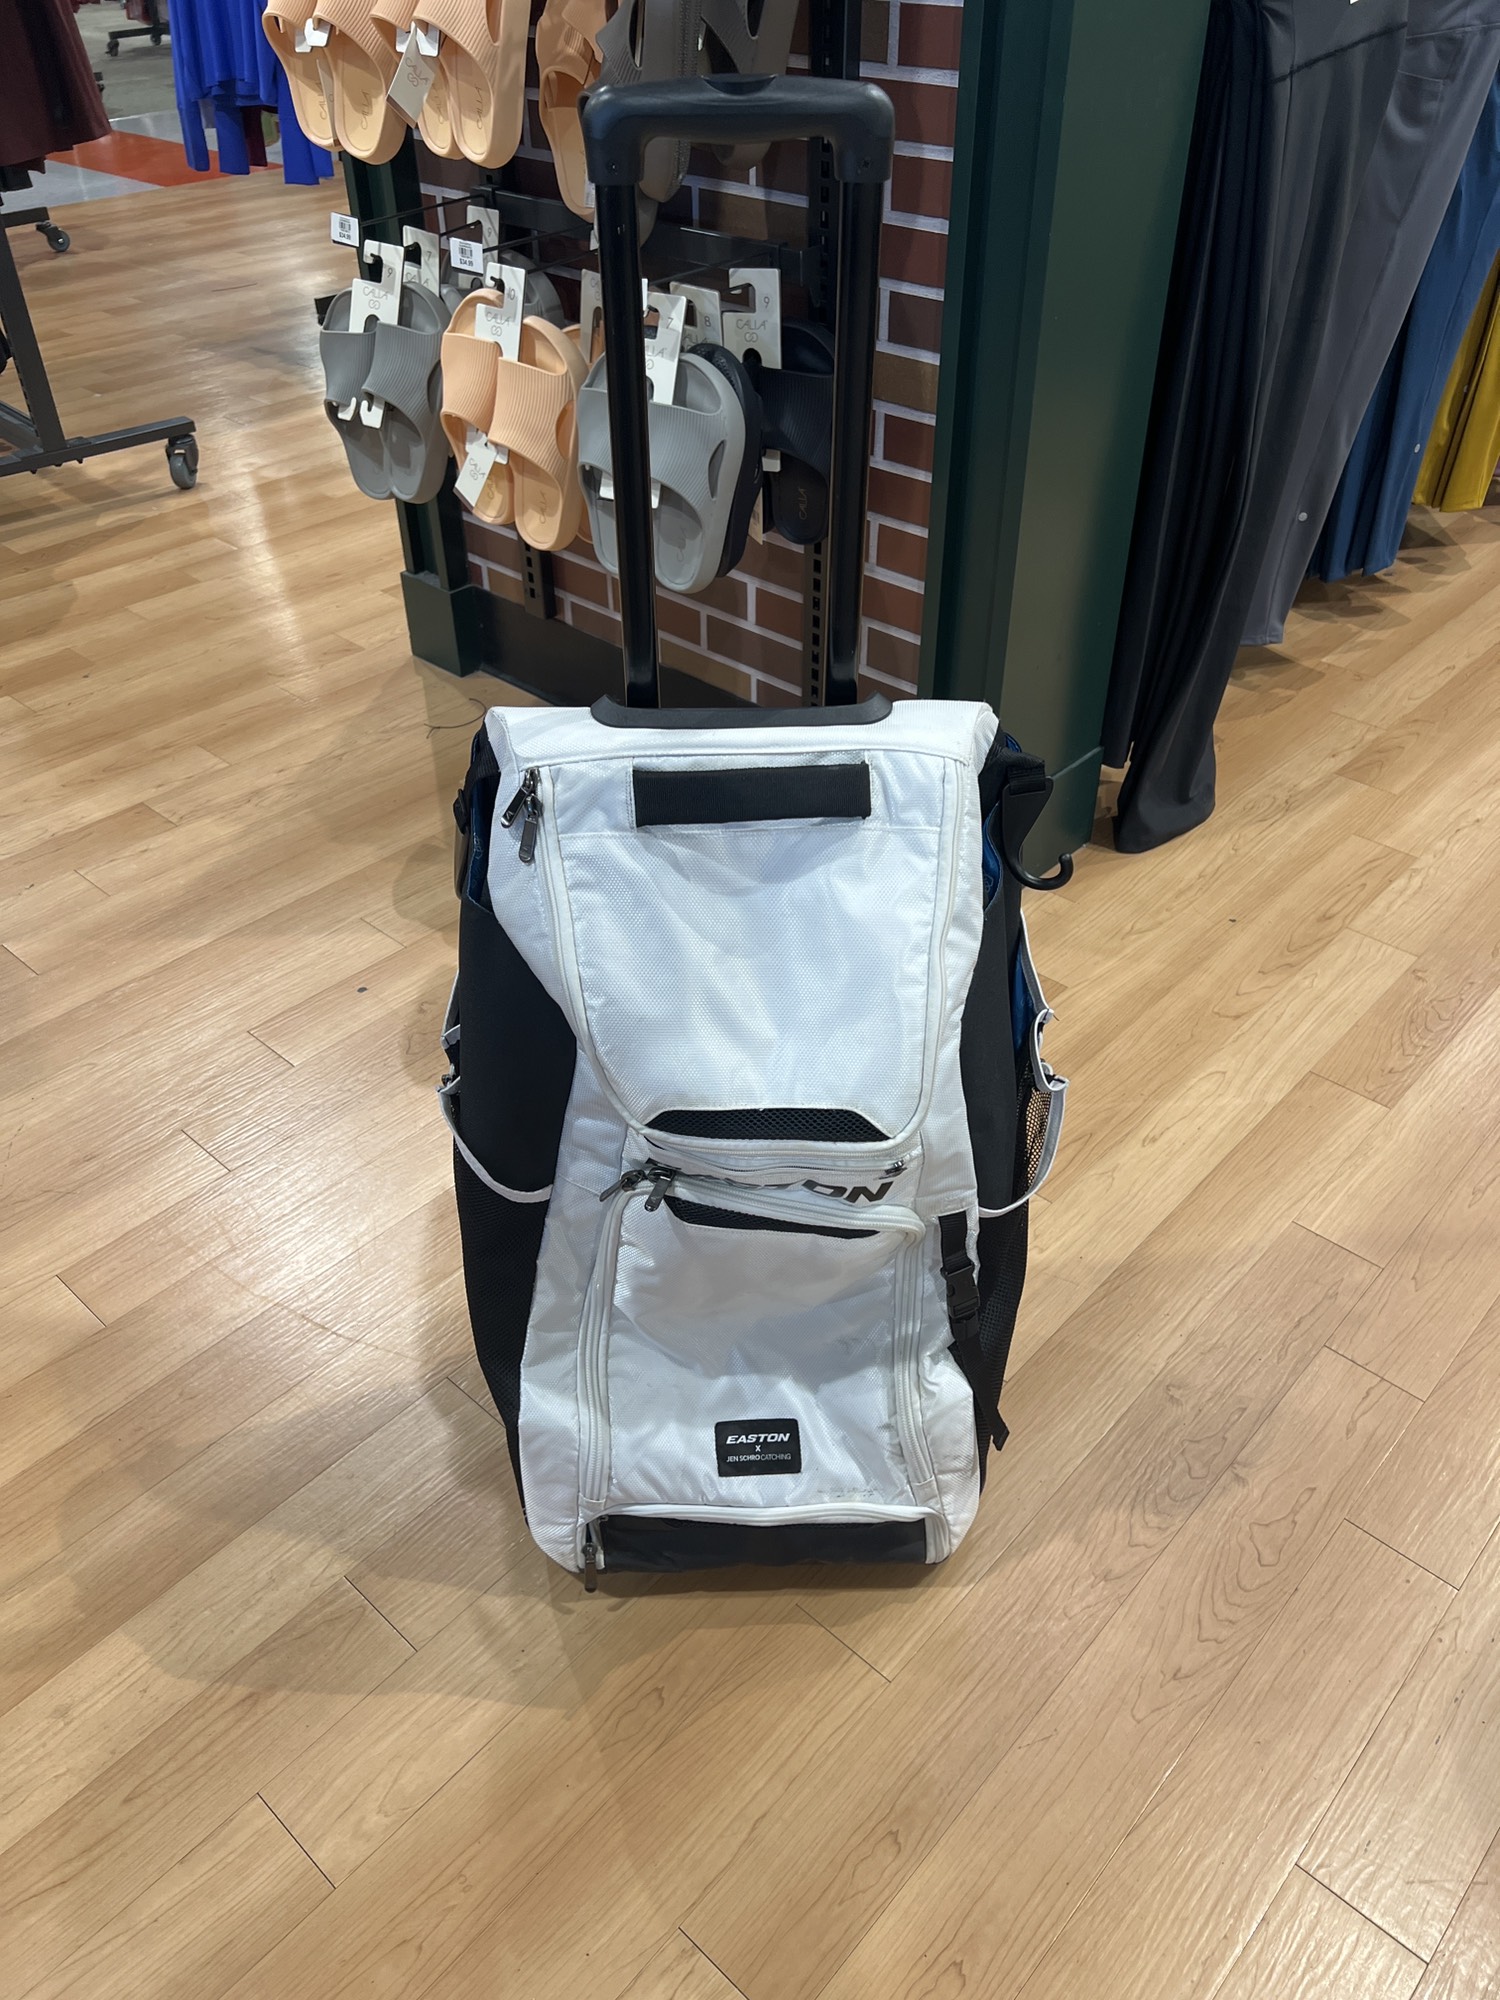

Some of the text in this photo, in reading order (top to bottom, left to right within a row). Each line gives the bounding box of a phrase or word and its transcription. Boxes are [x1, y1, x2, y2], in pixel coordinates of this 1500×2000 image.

[387, 267, 394, 279] 9
[763, 296, 770, 308] 9
[666, 317, 674, 329] 7
[703, 315, 711, 328] 8
[725, 1432, 791, 1445] EASTON
[726, 1455, 739, 1463] JEN
